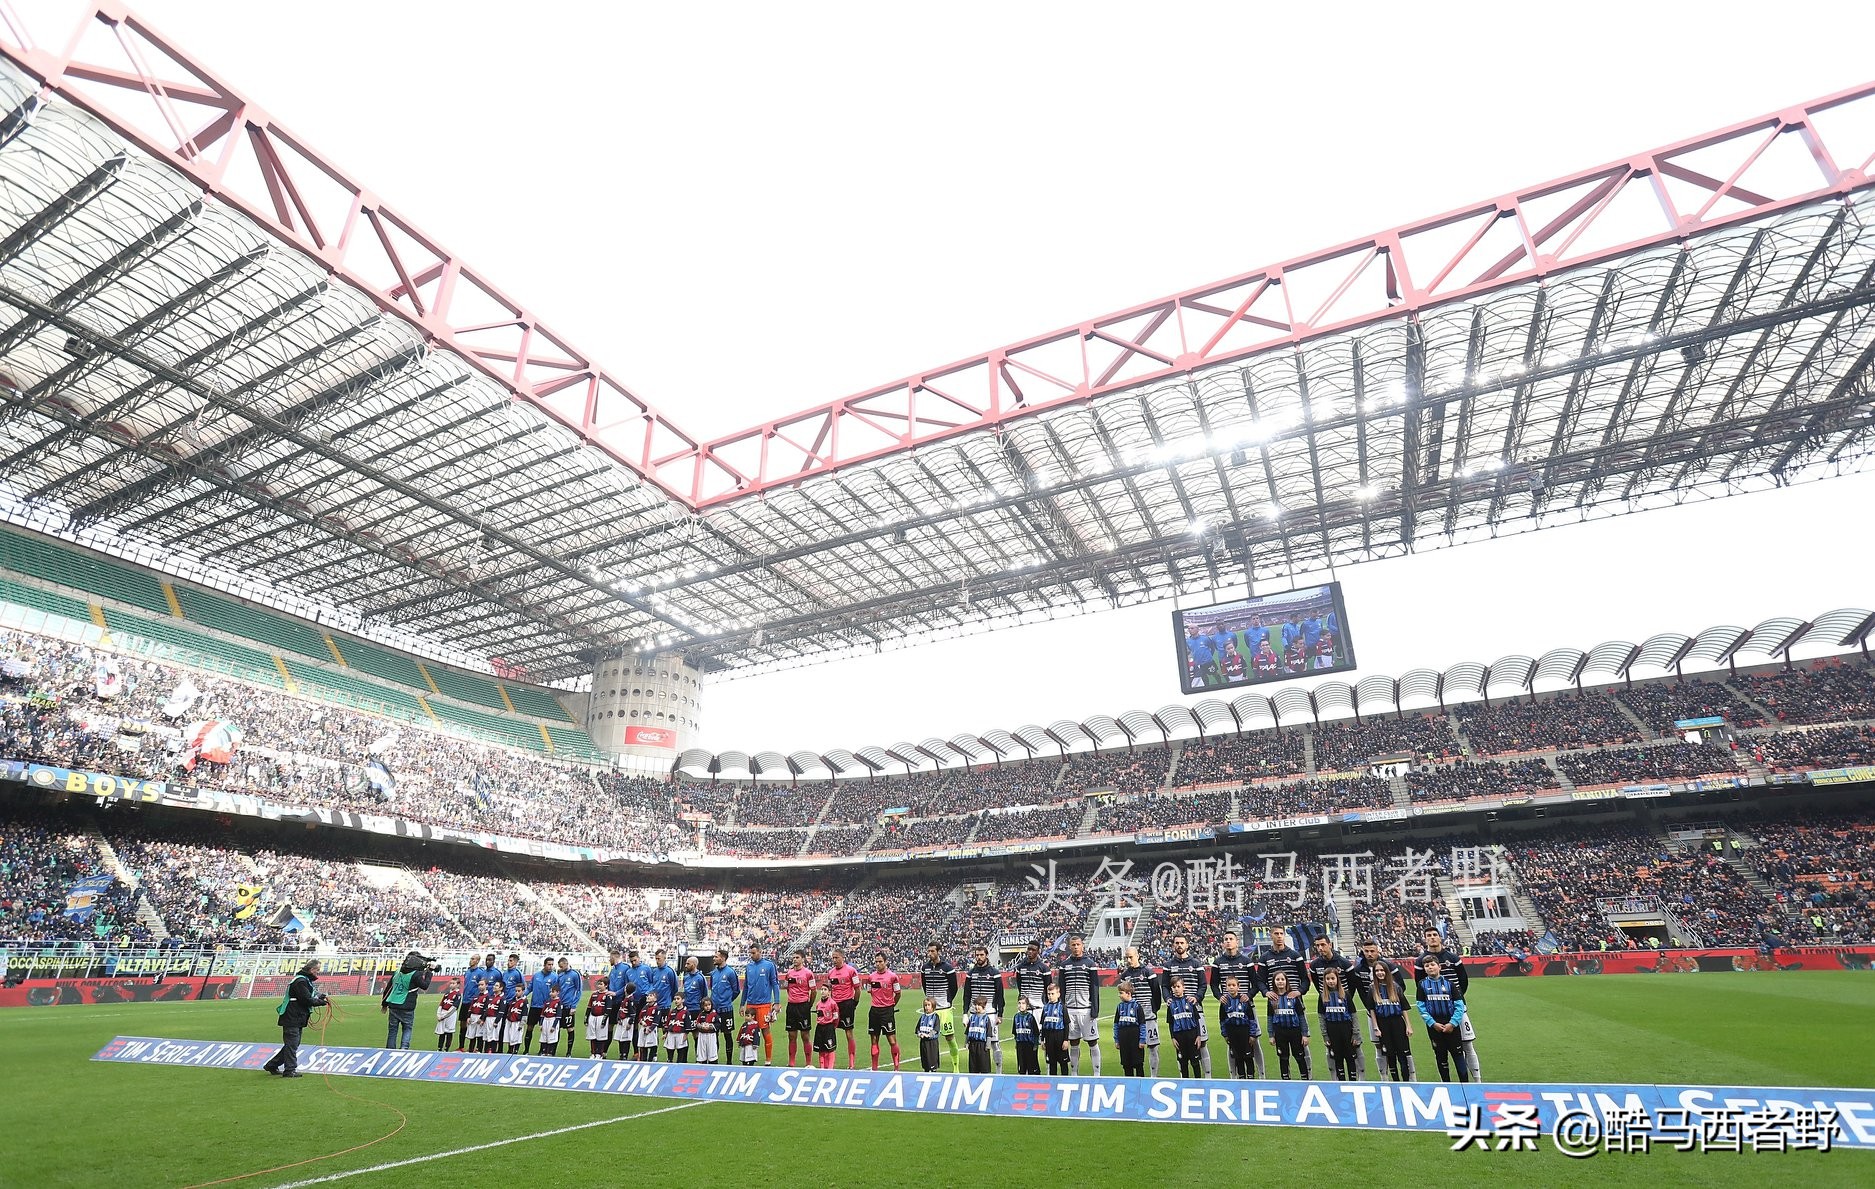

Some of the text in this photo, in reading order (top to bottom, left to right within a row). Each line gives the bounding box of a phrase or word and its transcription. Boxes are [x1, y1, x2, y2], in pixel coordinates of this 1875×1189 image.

[65, 772, 160, 802] BOYS
[1572, 789, 1619, 800] GENOVA
[1266, 817, 1320, 829] INTER Club
[943, 1022, 952, 1031] 83
[1147, 1028, 1158, 1039] 24
[1465, 1021, 1470, 1031] 8
[115, 1041, 152, 1059] TIM
[141, 1041, 198, 1064] SERIE
[185, 1043, 216, 1065] A
[203, 1044, 253, 1067] TIM
[299, 1047, 364, 1073] SERIE
[353, 1051, 382, 1075] A
[376, 1051, 433, 1078] TIM
[453, 1057, 668, 1093] TIM SERIE A TIM
[706, 1070, 994, 1111] TIM SERIE A TIM
[1057, 1081, 1456, 1128] TIM SERIE A TIM
